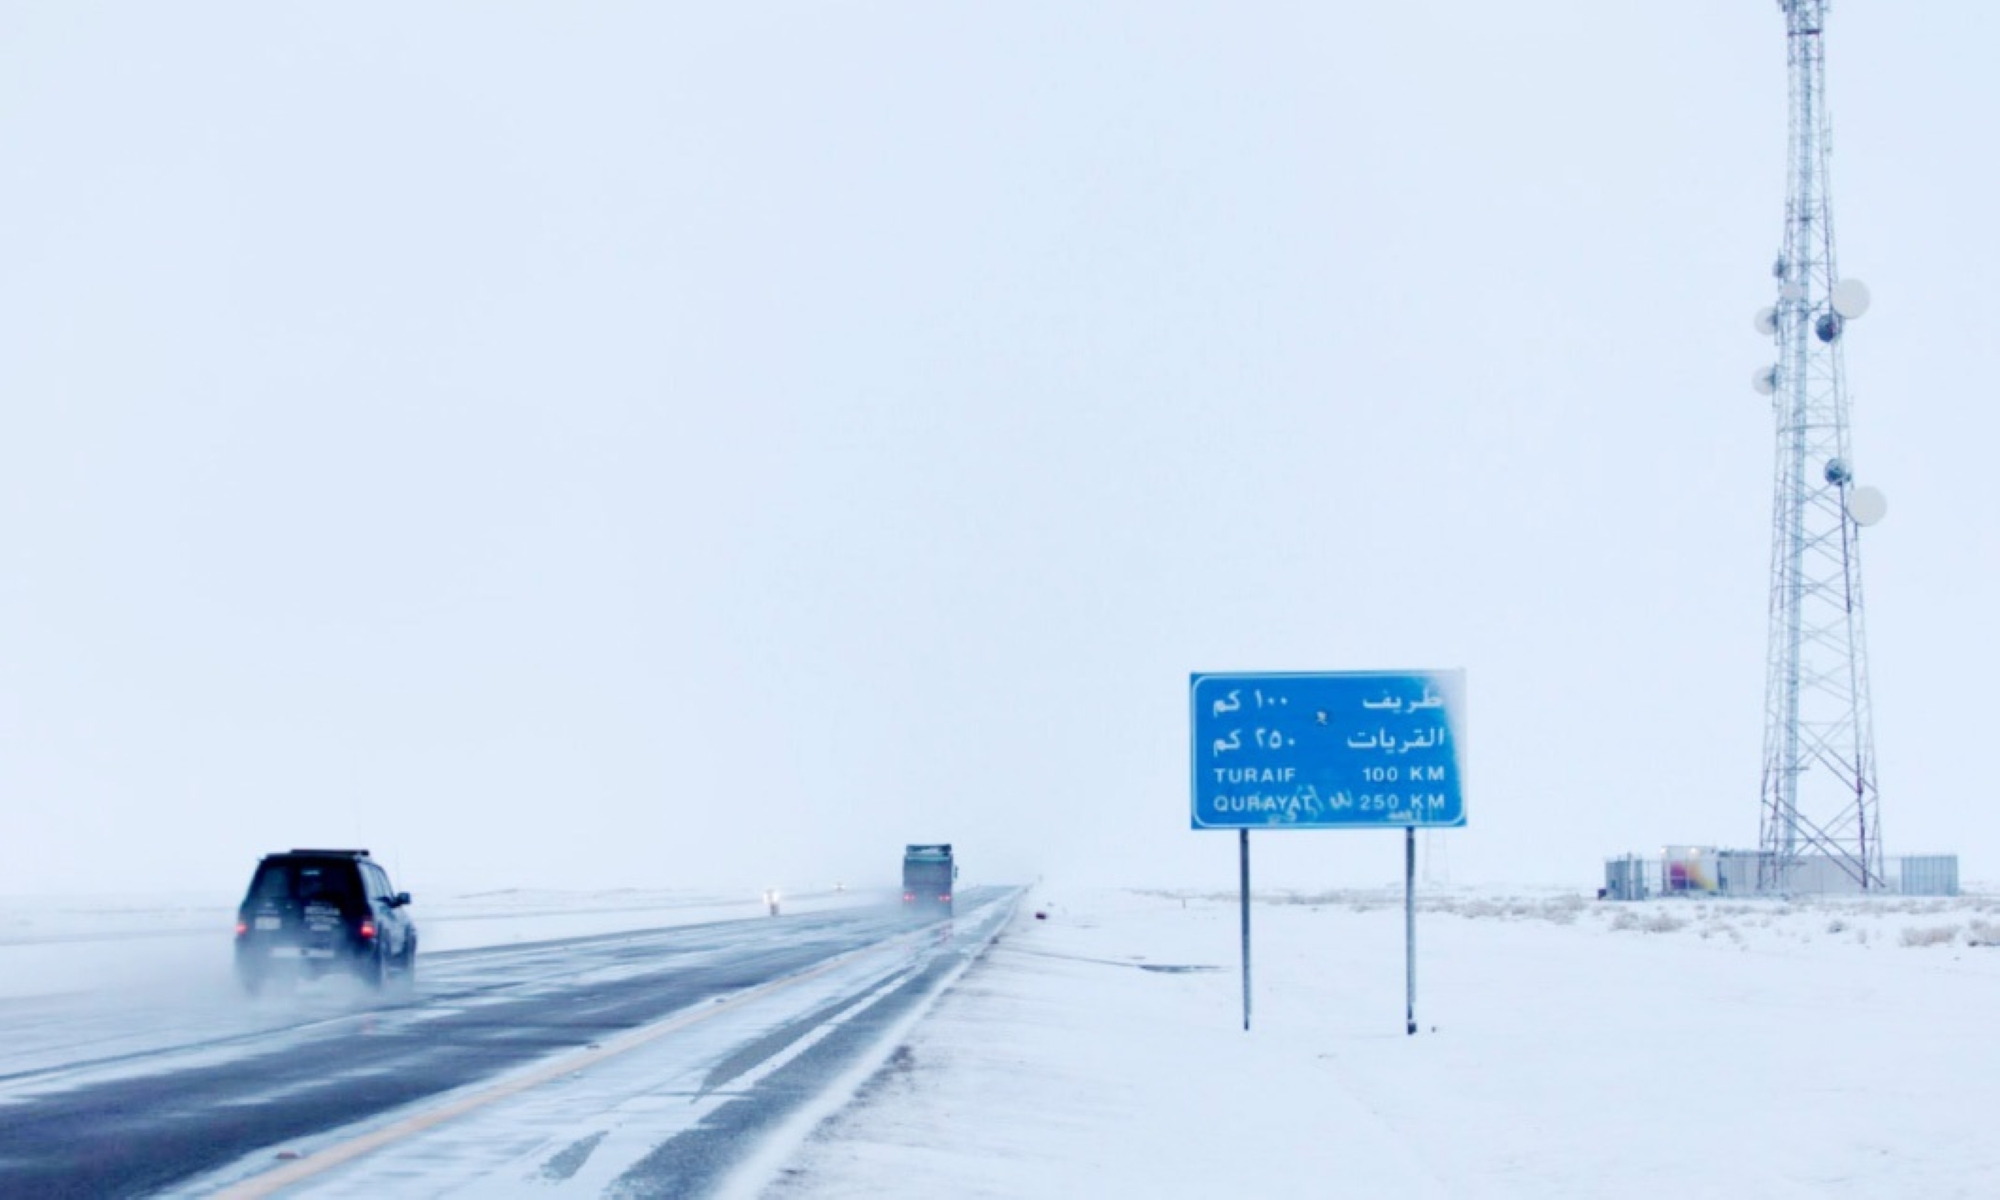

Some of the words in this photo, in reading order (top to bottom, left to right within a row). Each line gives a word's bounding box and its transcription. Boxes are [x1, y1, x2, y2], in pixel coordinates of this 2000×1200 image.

[1212, 689, 1241, 718] كم
[1255, 689, 1288, 707] ١٠٠
[1362, 686, 1443, 714] طريف
[1212, 728, 1242, 757] كم
[1255, 728, 1296, 749] ٢٥٠
[1347, 726, 1445, 753] القريات
[1213, 767, 1297, 783] TURAIF
[1362, 766, 1399, 782] 100
[1410, 766, 1445, 781] KM
[1213, 795, 1312, 812] QURAYAT
[1360, 794, 1399, 811] 250
[1410, 794, 1445, 811] KM
